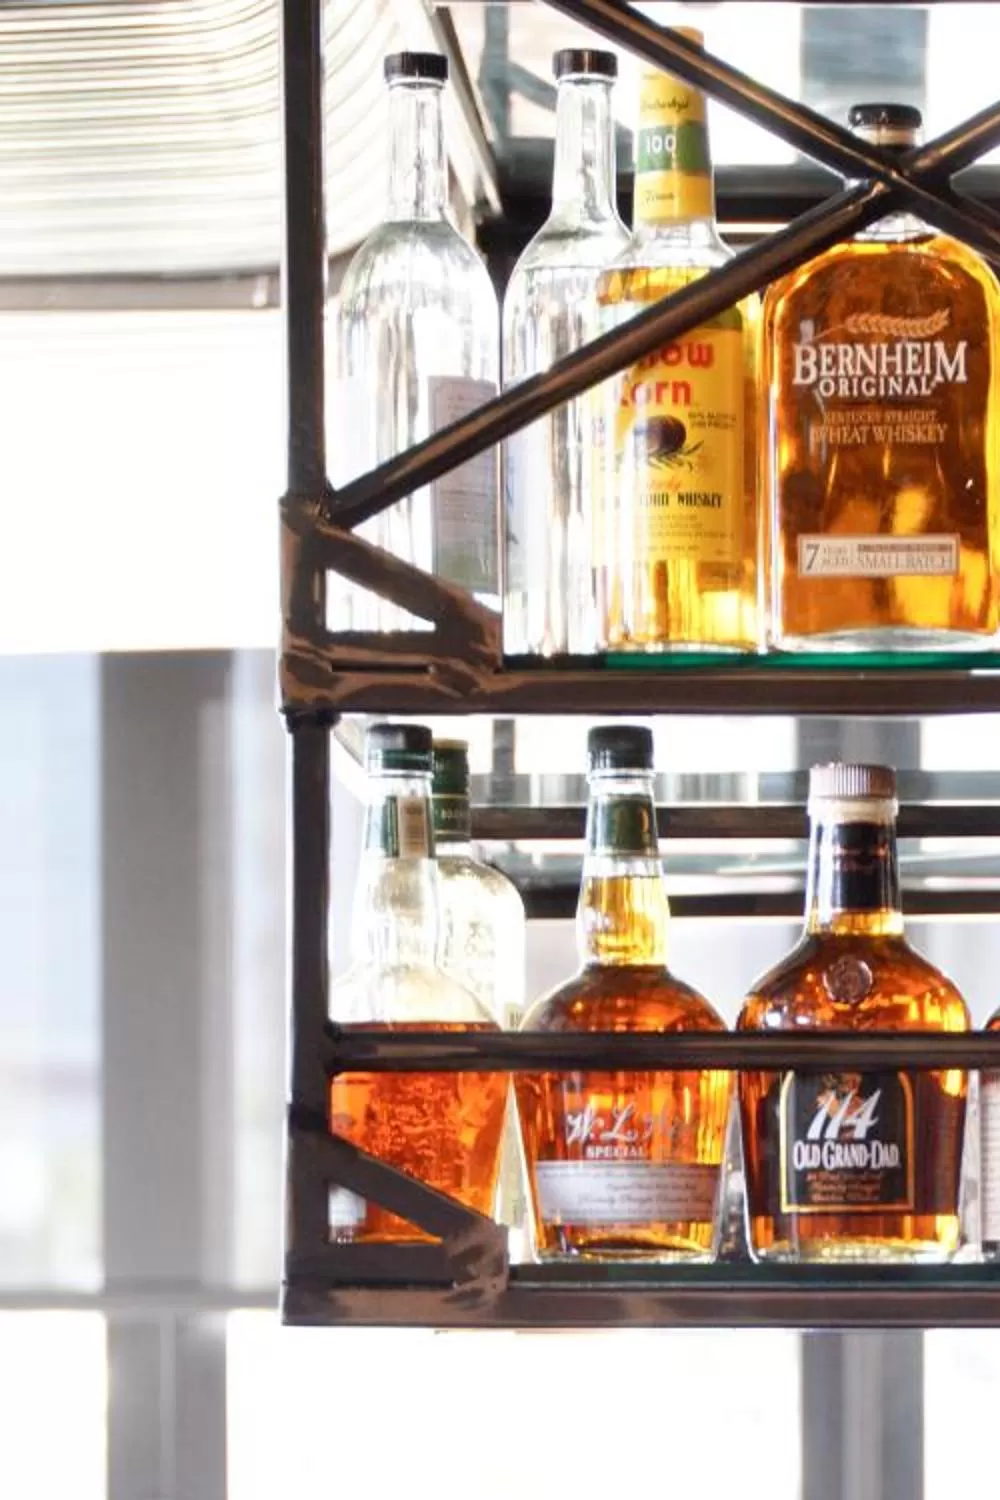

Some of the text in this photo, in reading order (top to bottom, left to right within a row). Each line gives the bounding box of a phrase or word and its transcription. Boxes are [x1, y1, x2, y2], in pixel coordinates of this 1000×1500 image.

[793, 340, 968, 385] BERNHEIM
[819, 376, 934, 398] ORIGINAL
[874, 424, 949, 445] WHISKEY
[806, 543, 820, 573] 7
[806, 1088, 882, 1141] 114
[793, 1140, 820, 1170] OLD
